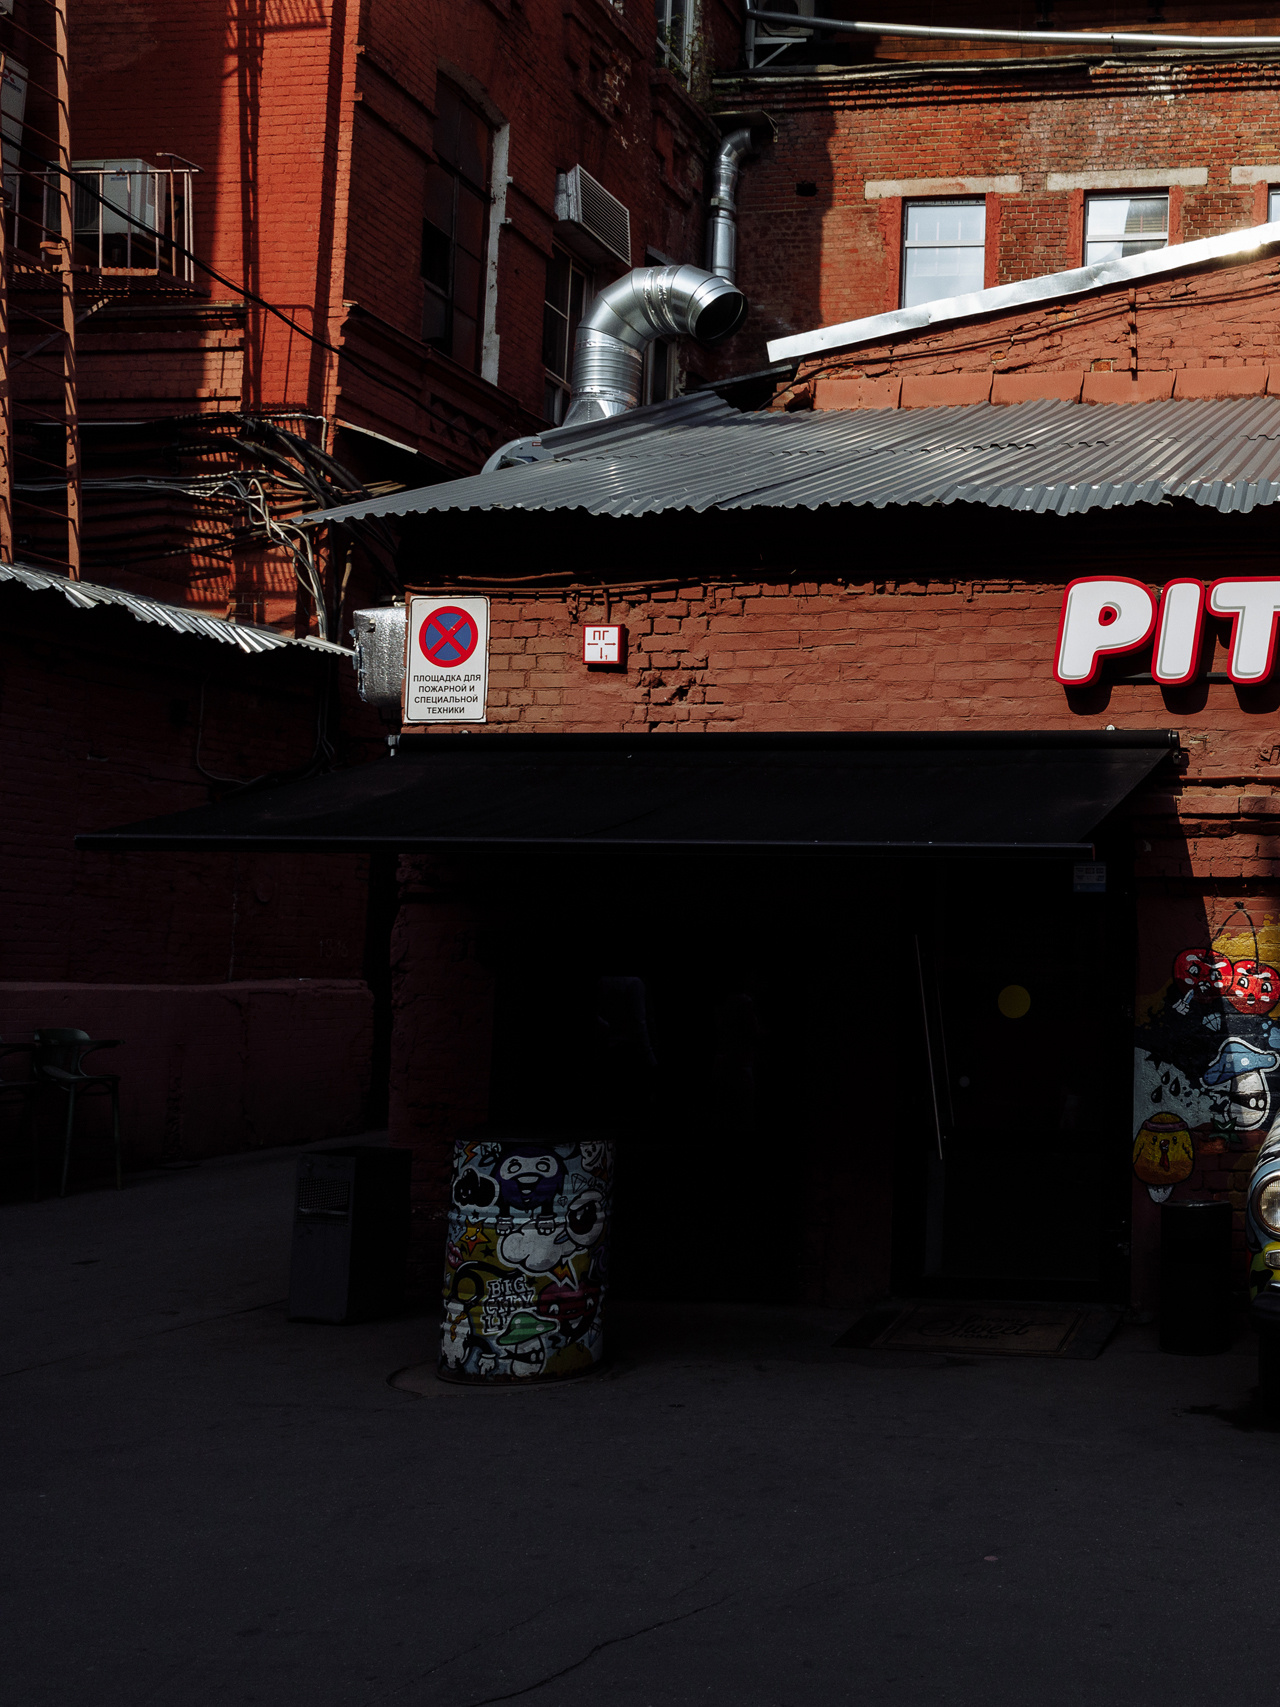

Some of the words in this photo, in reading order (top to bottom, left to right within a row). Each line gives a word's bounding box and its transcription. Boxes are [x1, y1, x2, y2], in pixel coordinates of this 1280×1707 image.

[593, 630, 610, 640] ПГ
[413, 674, 462, 683] ПЛОЩАДКА
[463, 674, 481, 682] ДЛЯ
[418, 684, 467, 693] ПОЖАРНОЙ
[414, 694, 479, 704] СПЕЦИАЛЬНОЙ
[427, 706, 465, 714] ТЕХНИКИ
[488, 1276, 527, 1298] BIG
[486, 1291, 535, 1315] CITY
[918, 1314, 1066, 1337] Sweet
